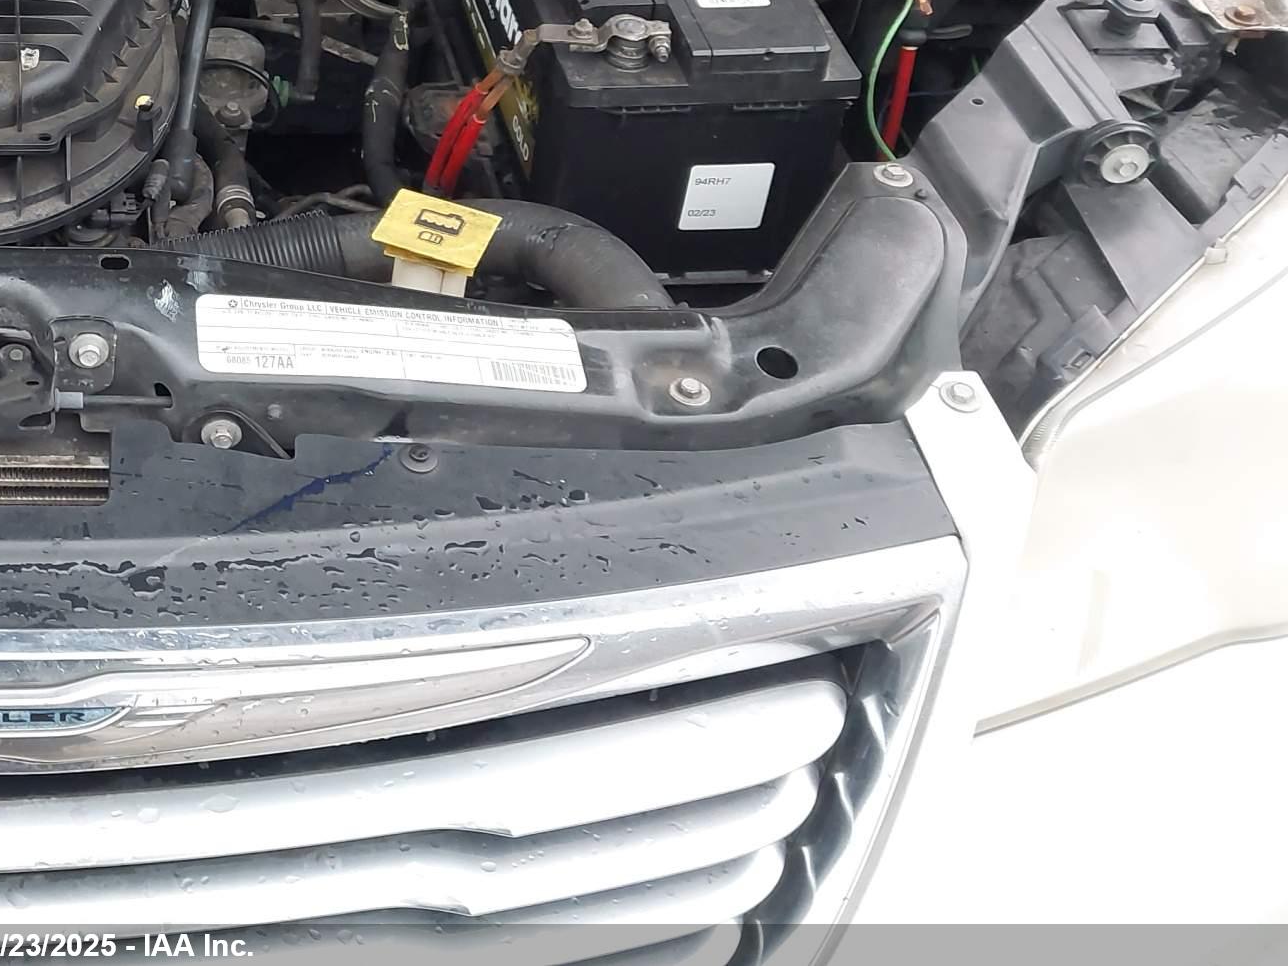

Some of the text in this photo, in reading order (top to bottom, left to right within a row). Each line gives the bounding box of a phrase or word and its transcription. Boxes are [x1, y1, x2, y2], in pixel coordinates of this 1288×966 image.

[512, 114, 530, 162] GOLD
[695, 178, 732, 186] 94RH7
[687, 209, 716, 217] 02/23
[244, 299, 322, 312] Chrysler Group LLC
[329, 305, 361, 315] VEHICLE
[364, 309, 403, 319] EMISSION
[405, 312, 442, 322] CONTROL
[444, 315, 499, 327] INFORMATION
[255, 356, 294, 369] 127AA
